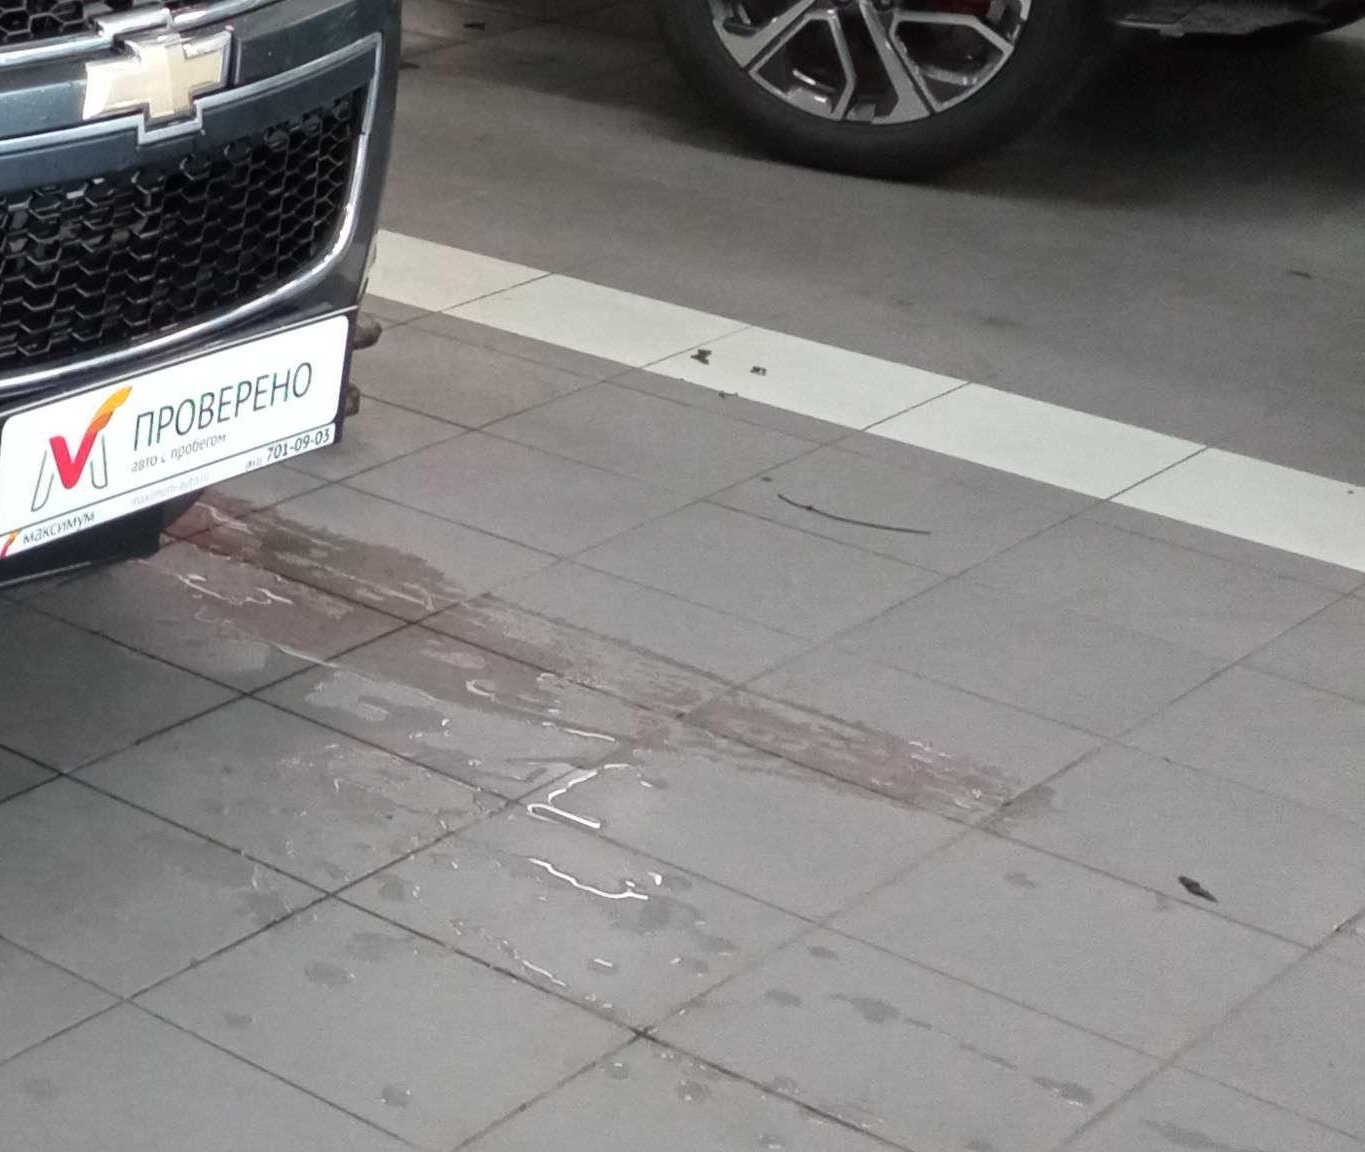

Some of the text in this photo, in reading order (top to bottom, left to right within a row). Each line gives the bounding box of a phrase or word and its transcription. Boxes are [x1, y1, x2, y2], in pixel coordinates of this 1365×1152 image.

[133, 361, 313, 451] ПРОВЕРЕНО
[131, 456, 158, 473] авто
[170, 433, 227, 462] пробегом
[266, 427, 331, 462] 701-09-03
